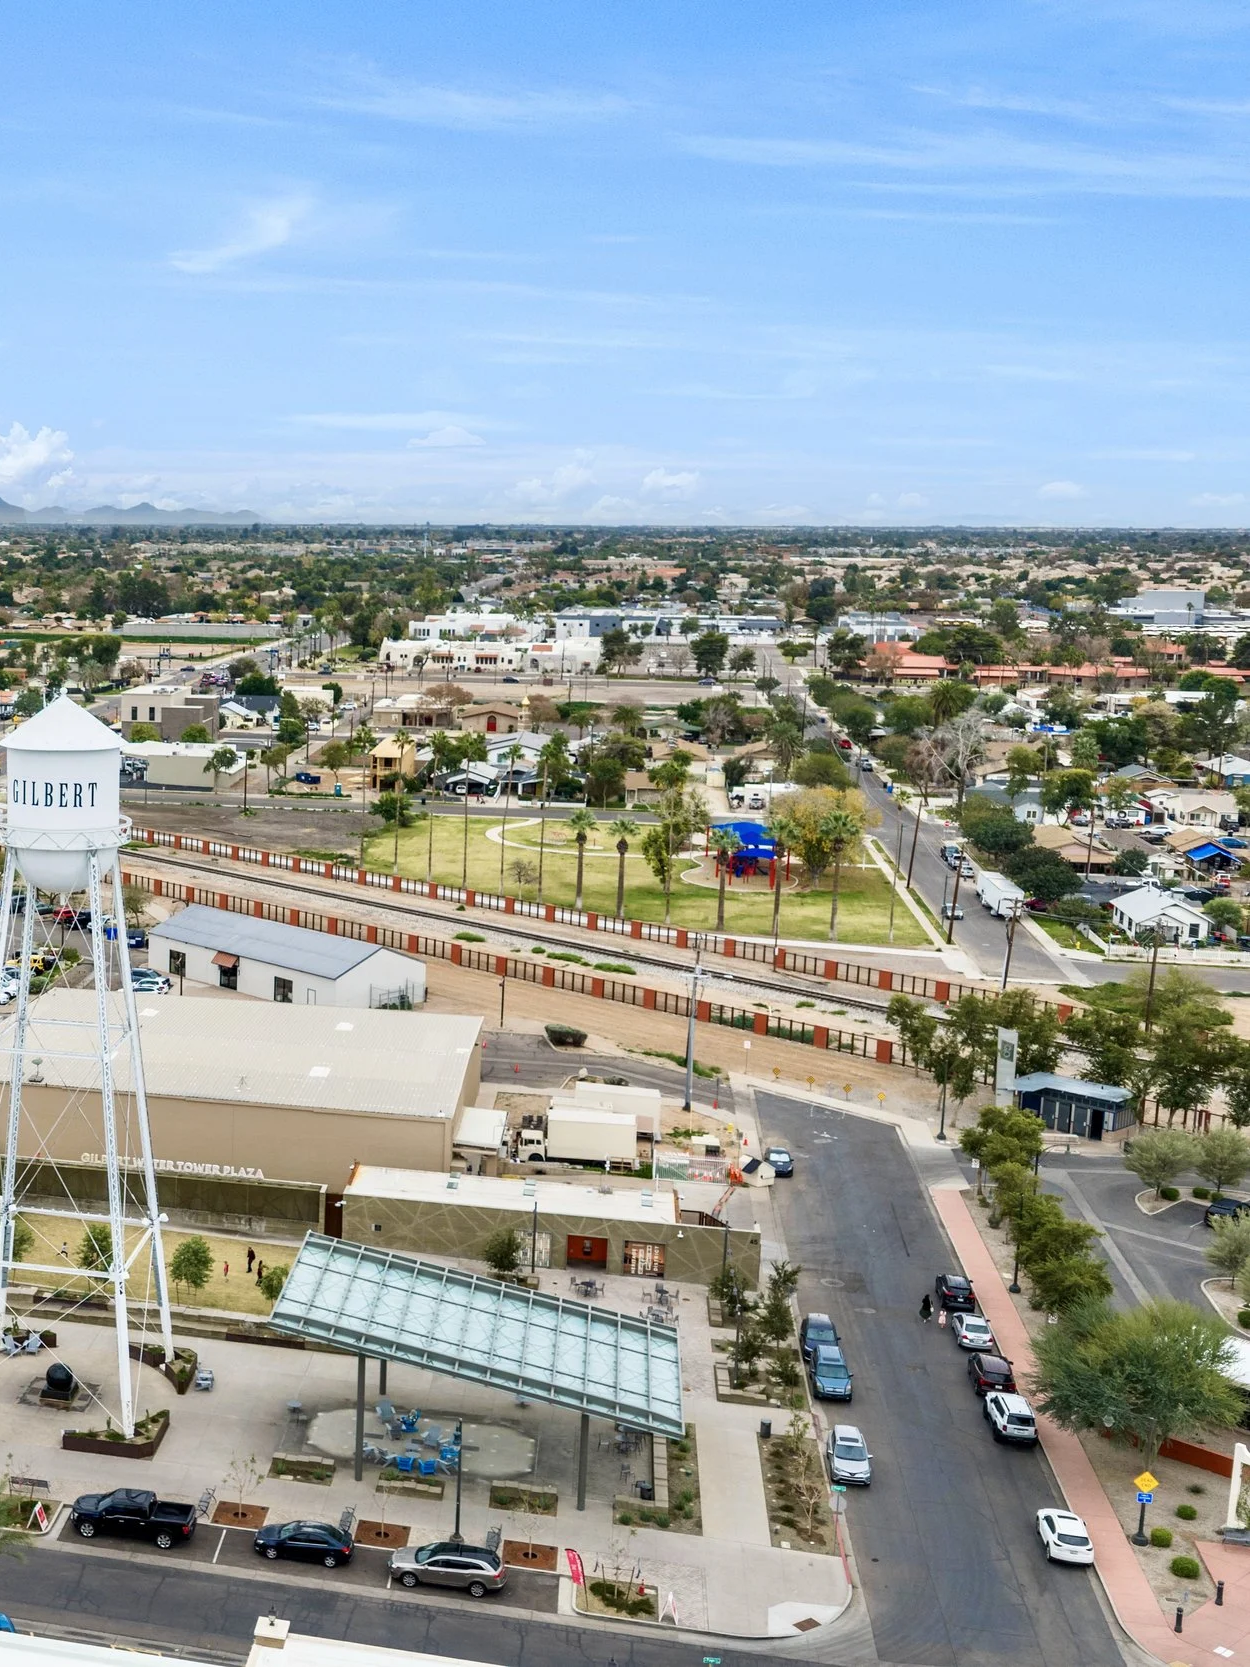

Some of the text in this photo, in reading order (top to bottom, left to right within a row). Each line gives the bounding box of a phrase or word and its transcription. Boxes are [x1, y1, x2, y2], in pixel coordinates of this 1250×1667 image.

[13, 779, 97, 807] GILBERT
[81, 1152, 264, 1179] GILBRT WTER TOWER PLAZA
